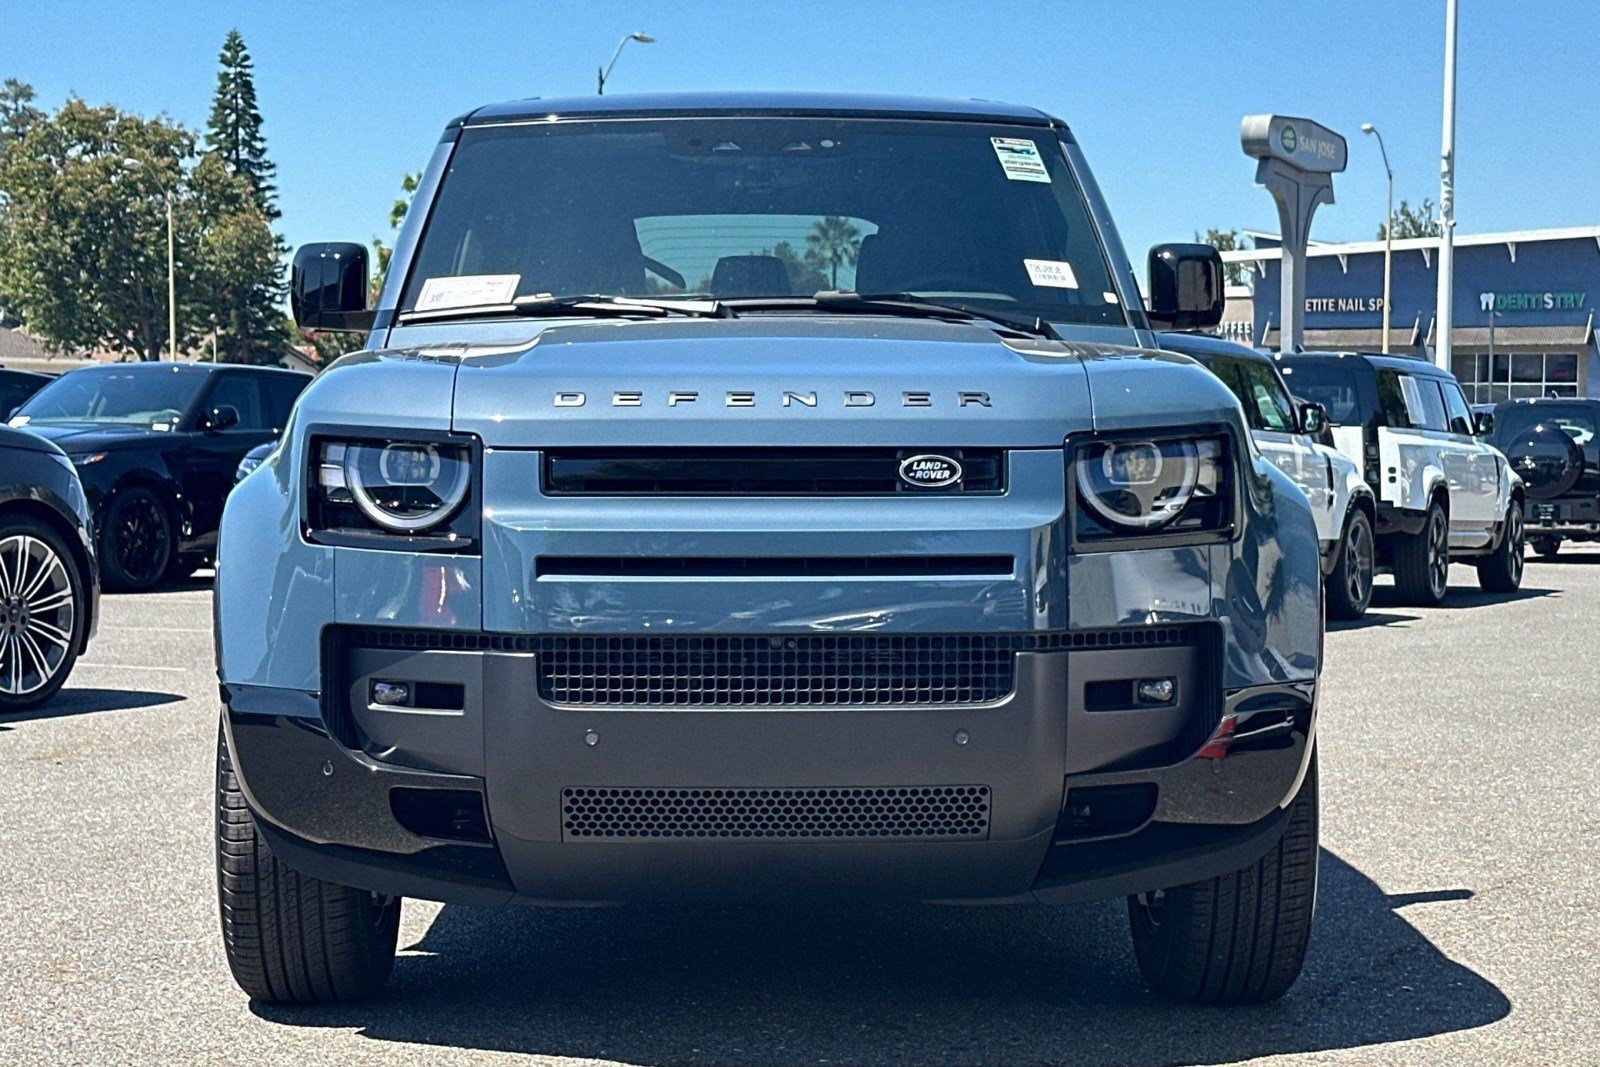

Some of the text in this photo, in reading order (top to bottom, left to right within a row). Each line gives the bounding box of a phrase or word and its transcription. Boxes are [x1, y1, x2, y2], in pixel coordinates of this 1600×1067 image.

[1300, 136, 1317, 153] SAN
[1317, 141, 1336, 160] JOSE
[1305, 297, 1391, 312] ETITE NAIL SP
[1495, 292, 1586, 310] DENTISTRY
[553, 391, 993, 407] DEFENDER
